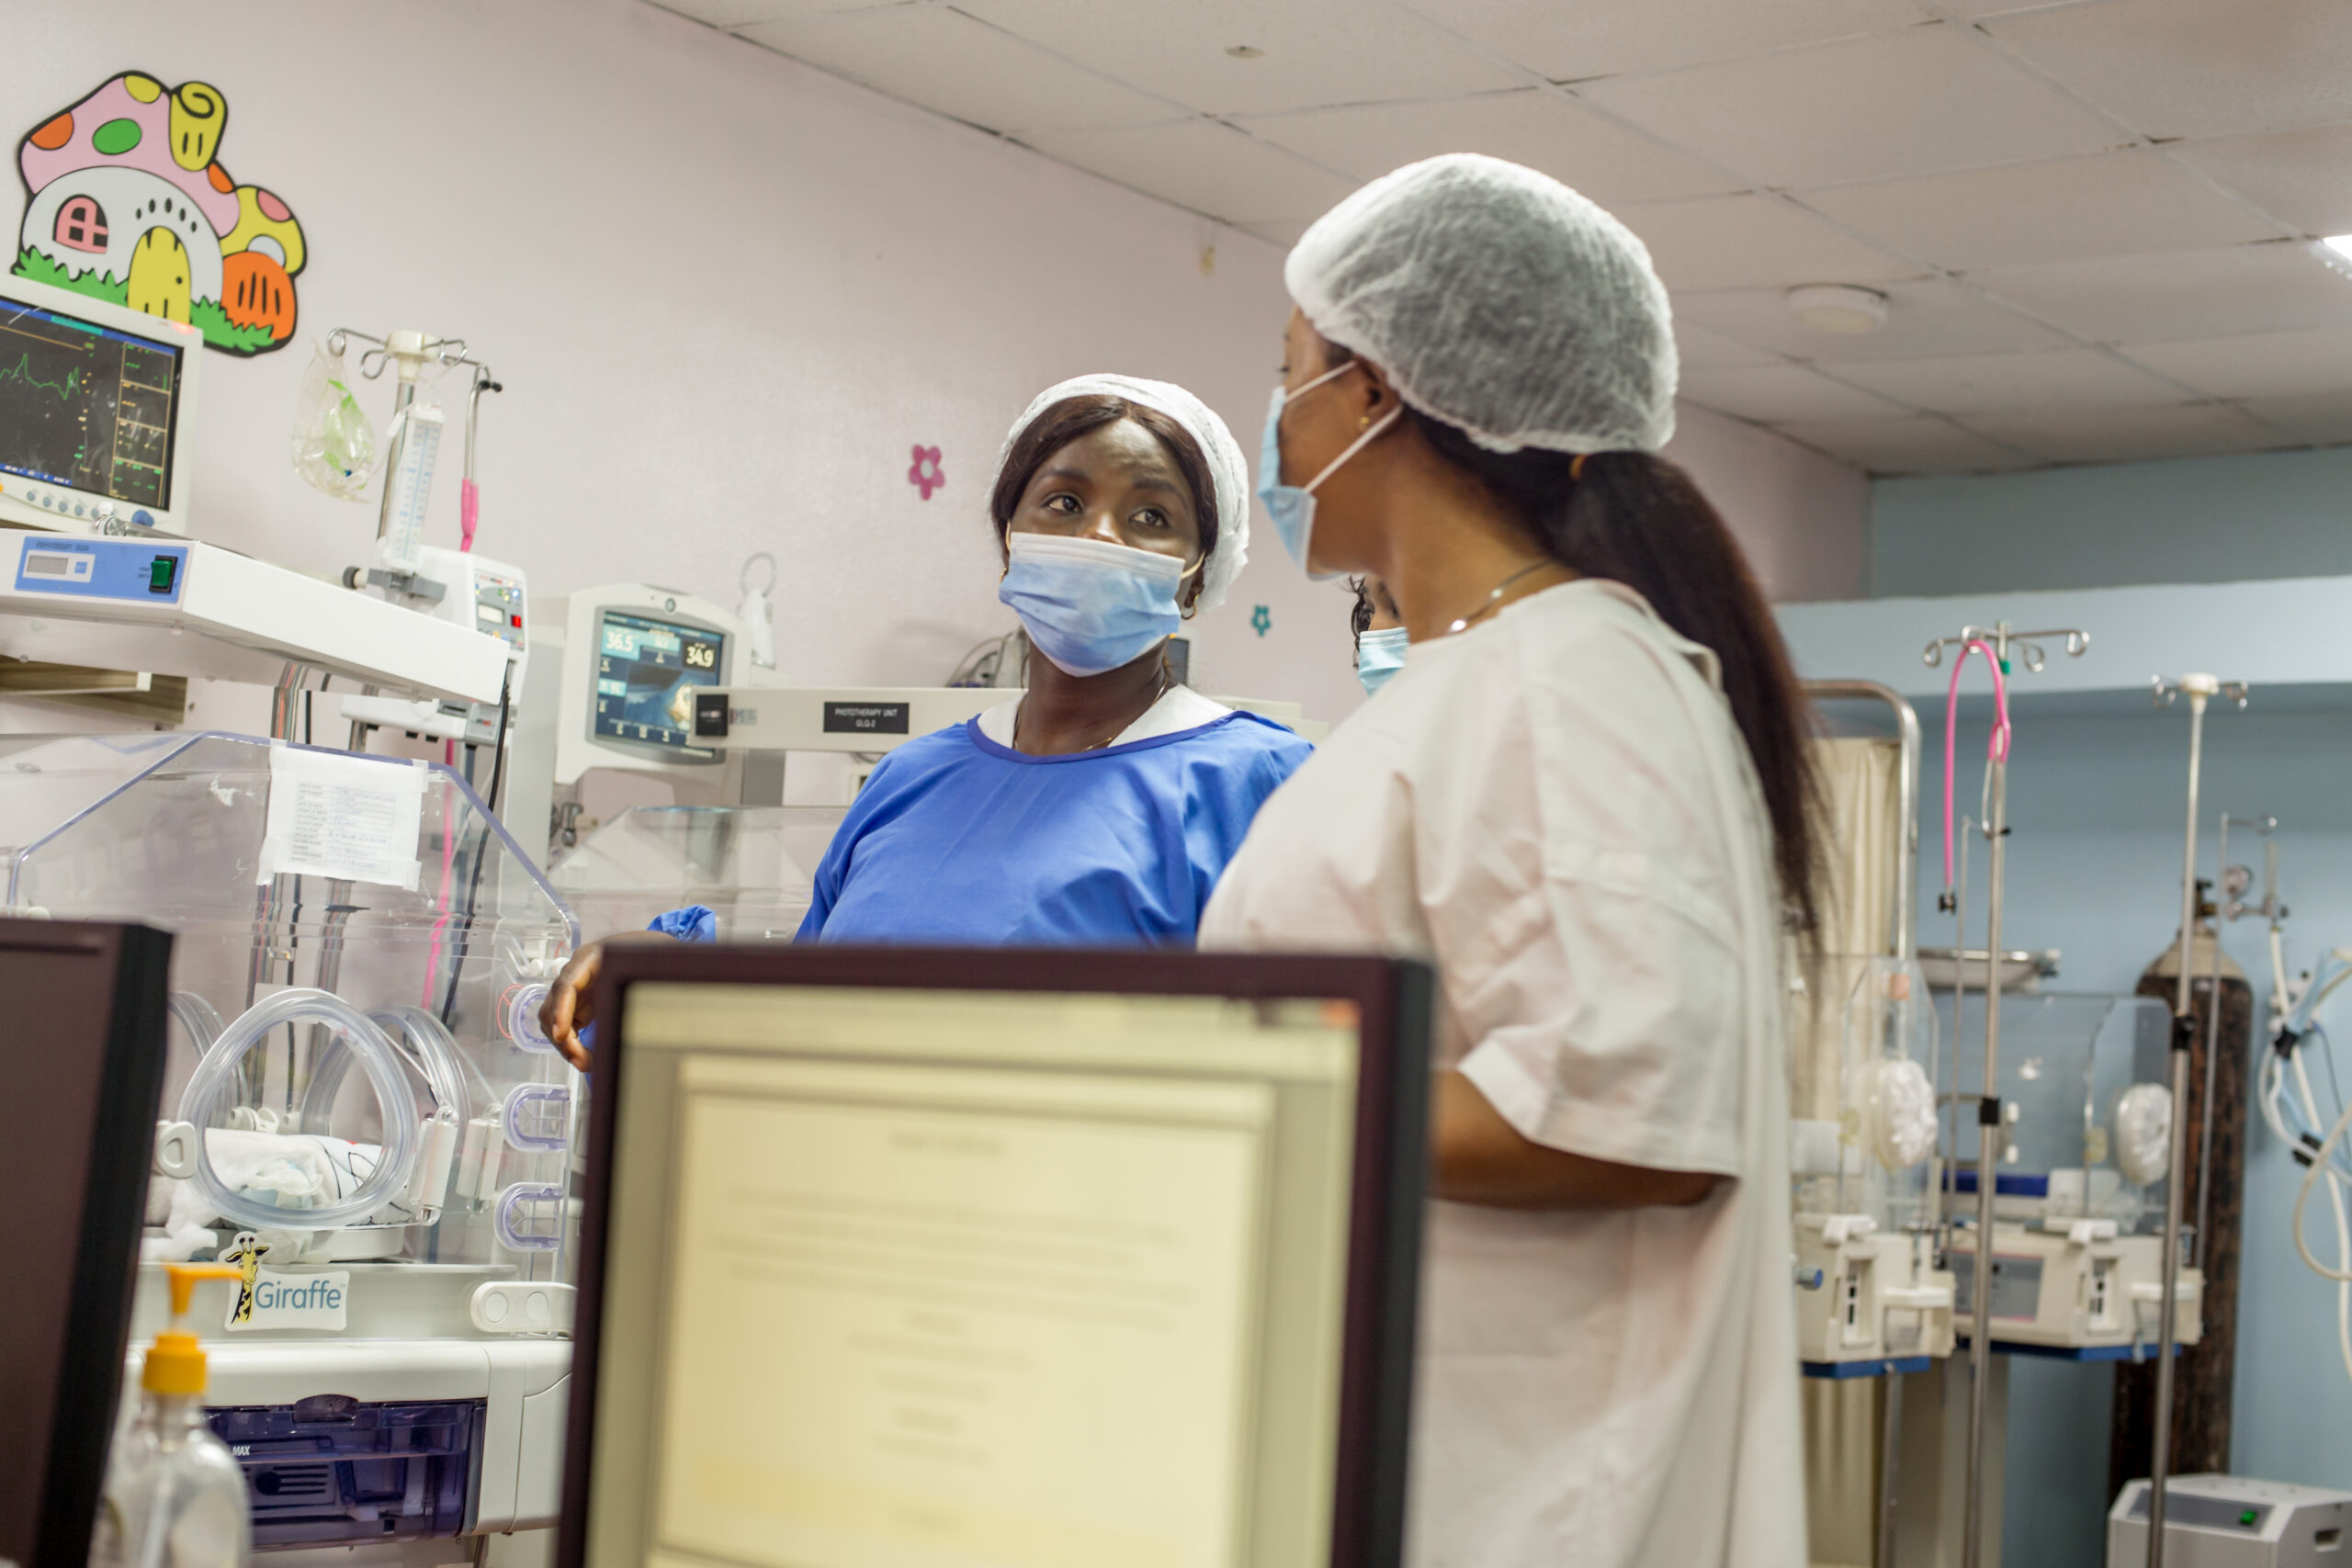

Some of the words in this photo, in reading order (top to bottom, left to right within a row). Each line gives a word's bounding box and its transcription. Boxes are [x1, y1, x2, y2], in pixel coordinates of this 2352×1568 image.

[605, 631, 634, 653] 36.5
[685, 646, 715, 668] 34.9
[834, 707, 882, 717] PHOTOTHERAPY
[883, 708, 899, 717] UNIT
[254, 1280, 342, 1309] Giraffe
[232, 1445, 251, 1456] MAX
